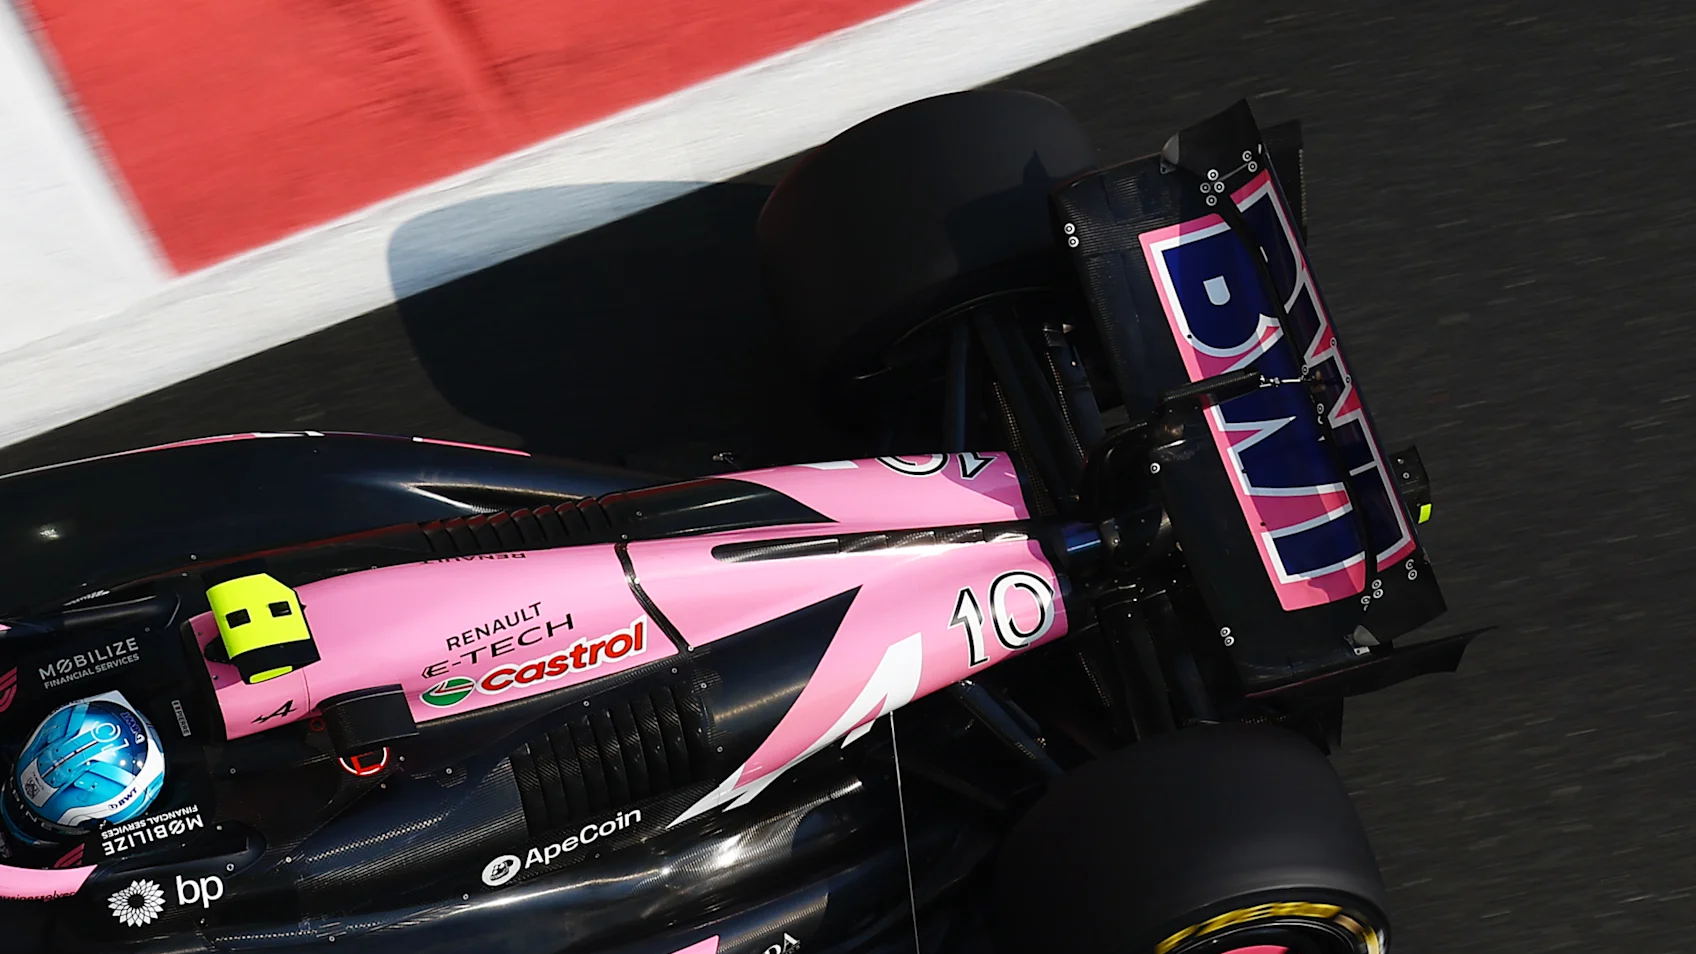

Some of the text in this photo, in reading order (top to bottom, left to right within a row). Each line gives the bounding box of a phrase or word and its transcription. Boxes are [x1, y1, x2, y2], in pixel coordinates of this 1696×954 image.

[1149, 184, 1410, 584] BWT
[421, 612, 575, 680] E-TECH
[446, 601, 541, 651] RENAULT
[948, 570, 1056, 668] 10
[44, 653, 140, 689] FINANCIAL SERVICES
[479, 618, 646, 694] Castrol
[101, 804, 199, 839] FINANCIAL SERVICES
[524, 807, 642, 870] ApeCoin
[175, 875, 226, 908] bp
